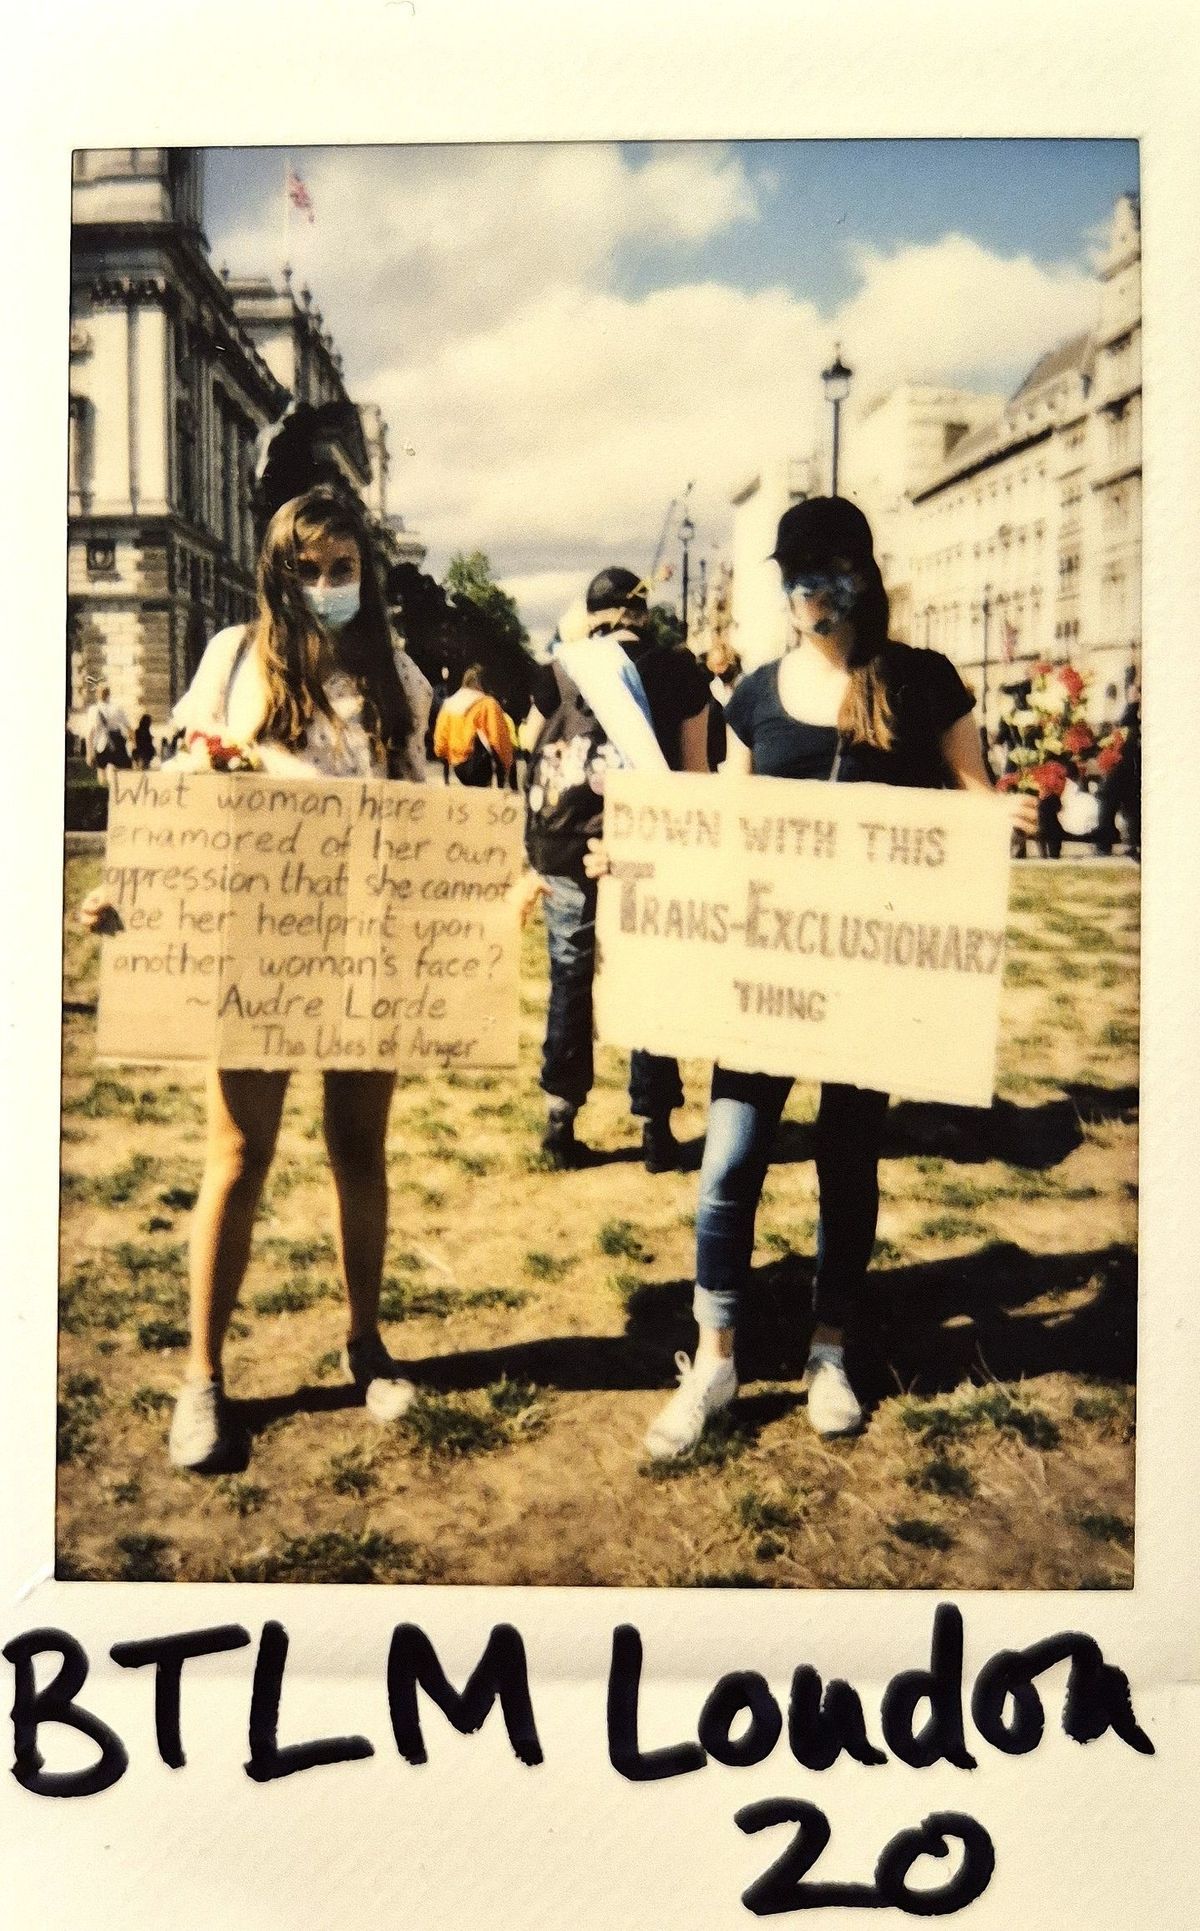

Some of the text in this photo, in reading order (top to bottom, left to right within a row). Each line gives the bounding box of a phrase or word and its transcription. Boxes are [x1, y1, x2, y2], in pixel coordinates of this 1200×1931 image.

[113, 768, 517, 825] What woman here is so
[108, 821, 507, 865] enamored of her own
[613, 802, 948, 868] DOWN WITH THIS
[101, 861, 514, 907] oppression that she cannot
[178, 899, 236, 933] her
[257, 901, 398, 952] heelprint
[414, 919, 486, 951] upon
[112, 942, 504, 980] another woman's face?
[346, 984, 446, 1019] Lorde
[732, 978, 827, 1022] THING
[315, 1025, 367, 1058] Uses
[377, 1024, 400, 1056] of
[411, 1026, 480, 1068] Anger
[2, 1600, 1156, 1800] BTLM London
[733, 1796, 996, 1917] 20
